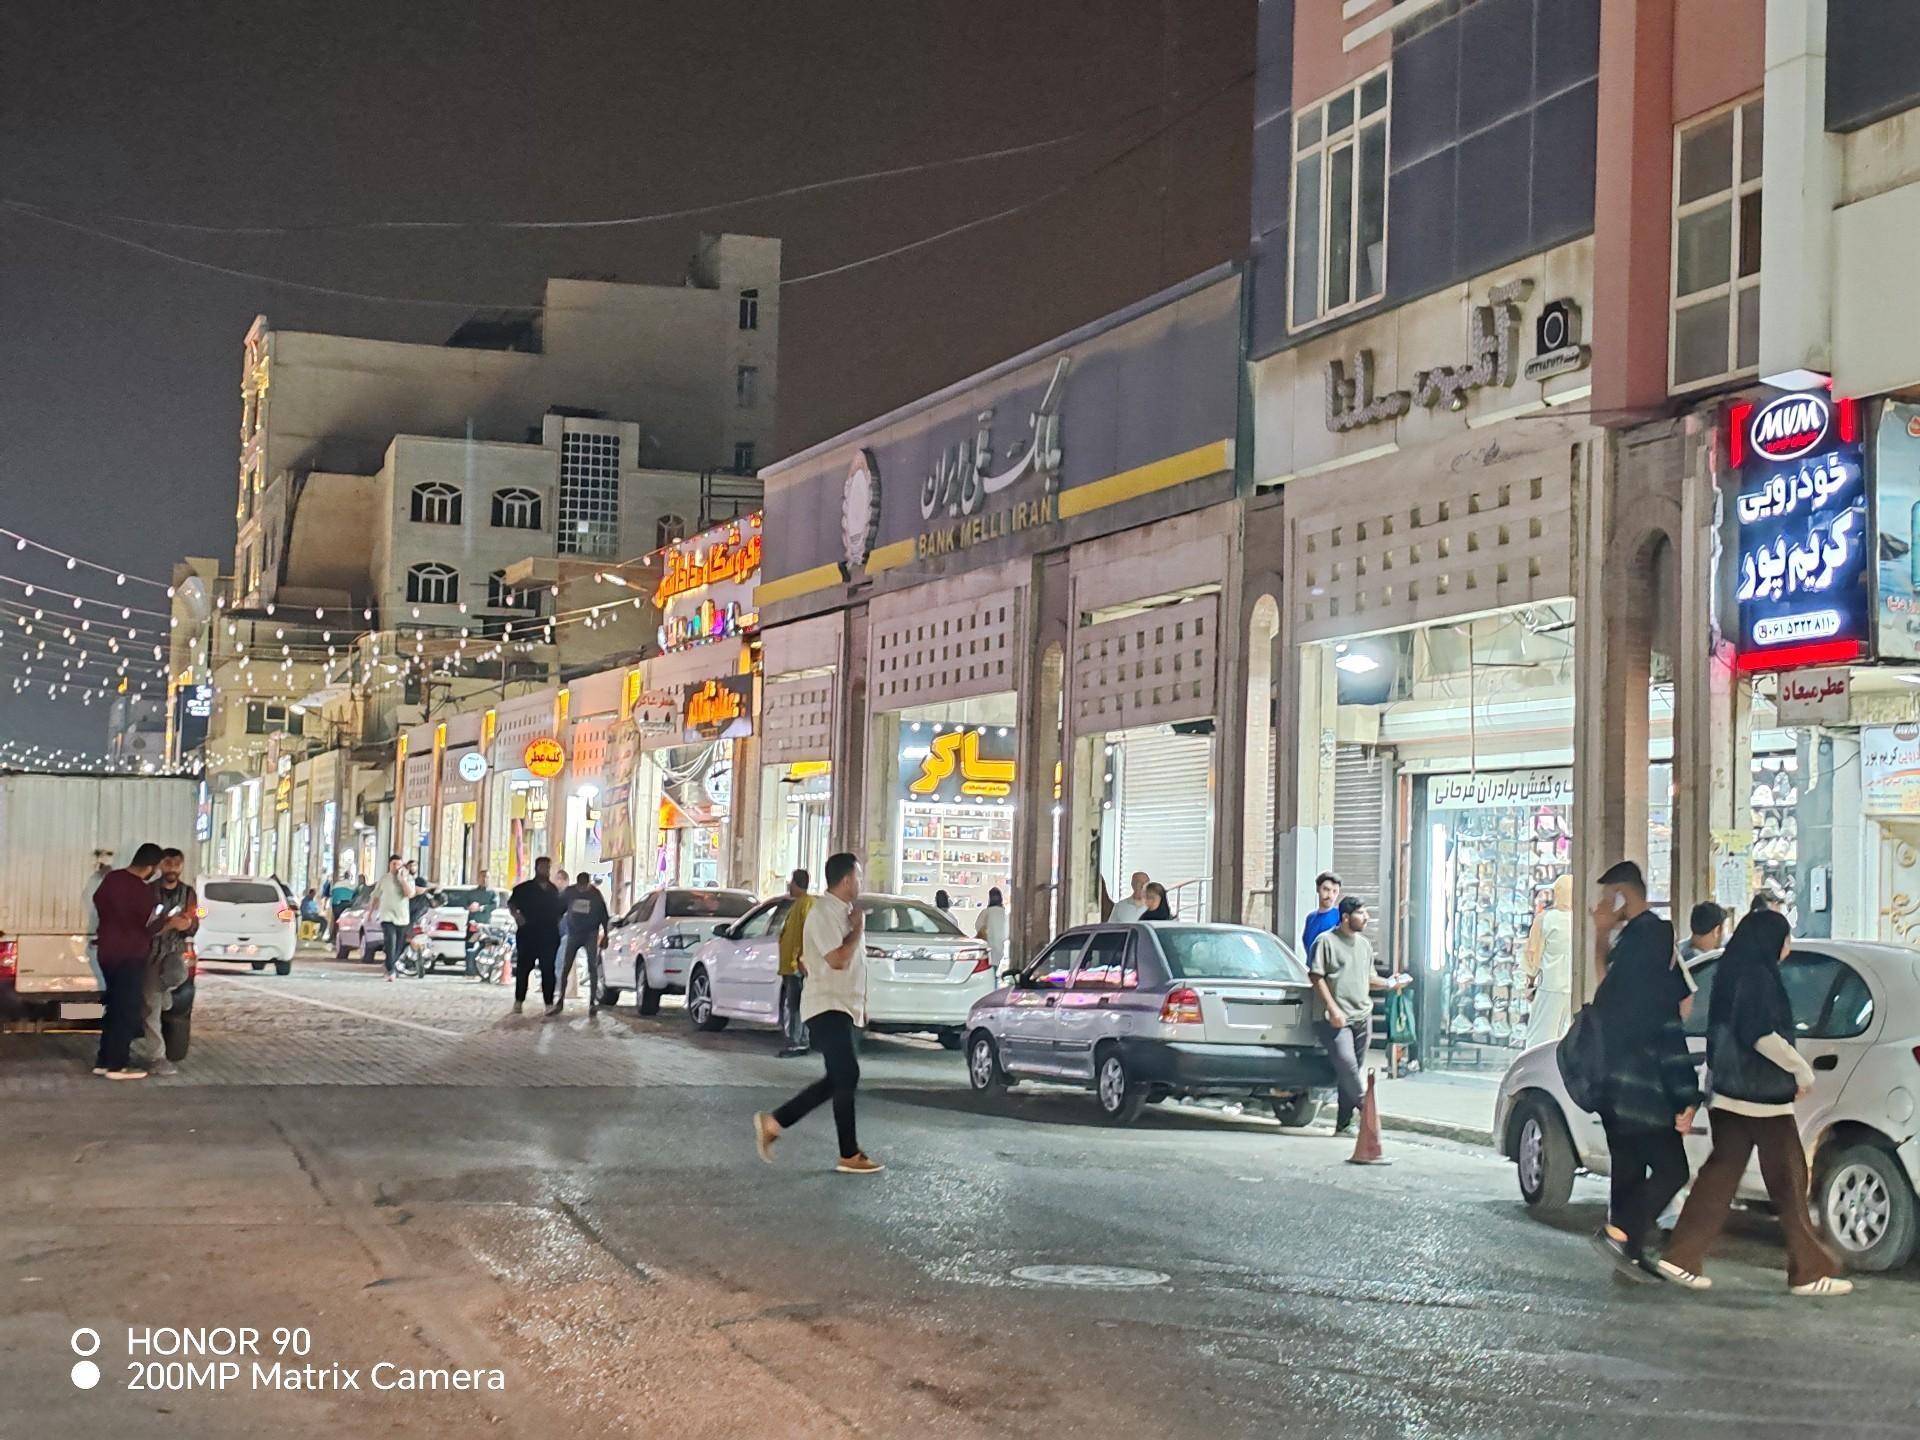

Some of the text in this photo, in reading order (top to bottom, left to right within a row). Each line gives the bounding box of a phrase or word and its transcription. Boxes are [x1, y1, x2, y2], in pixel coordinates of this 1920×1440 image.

[984, 357, 1069, 494] بانک
[1757, 401, 1820, 442] MVM
[921, 440, 974, 520] ایران
[1737, 452, 1847, 524] خودرویی
[918, 496, 1051, 560] BANK MELLI IRAN
[1737, 508, 1853, 601] کریم پور
[1783, 676, 1845, 706] عطر میعاد
[1434, 776, 1476, 804] فرحانی
[1477, 777, 1519, 803] برادران
[1520, 772, 1553, 800] کفش
[1554, 780, 1561, 799] و
